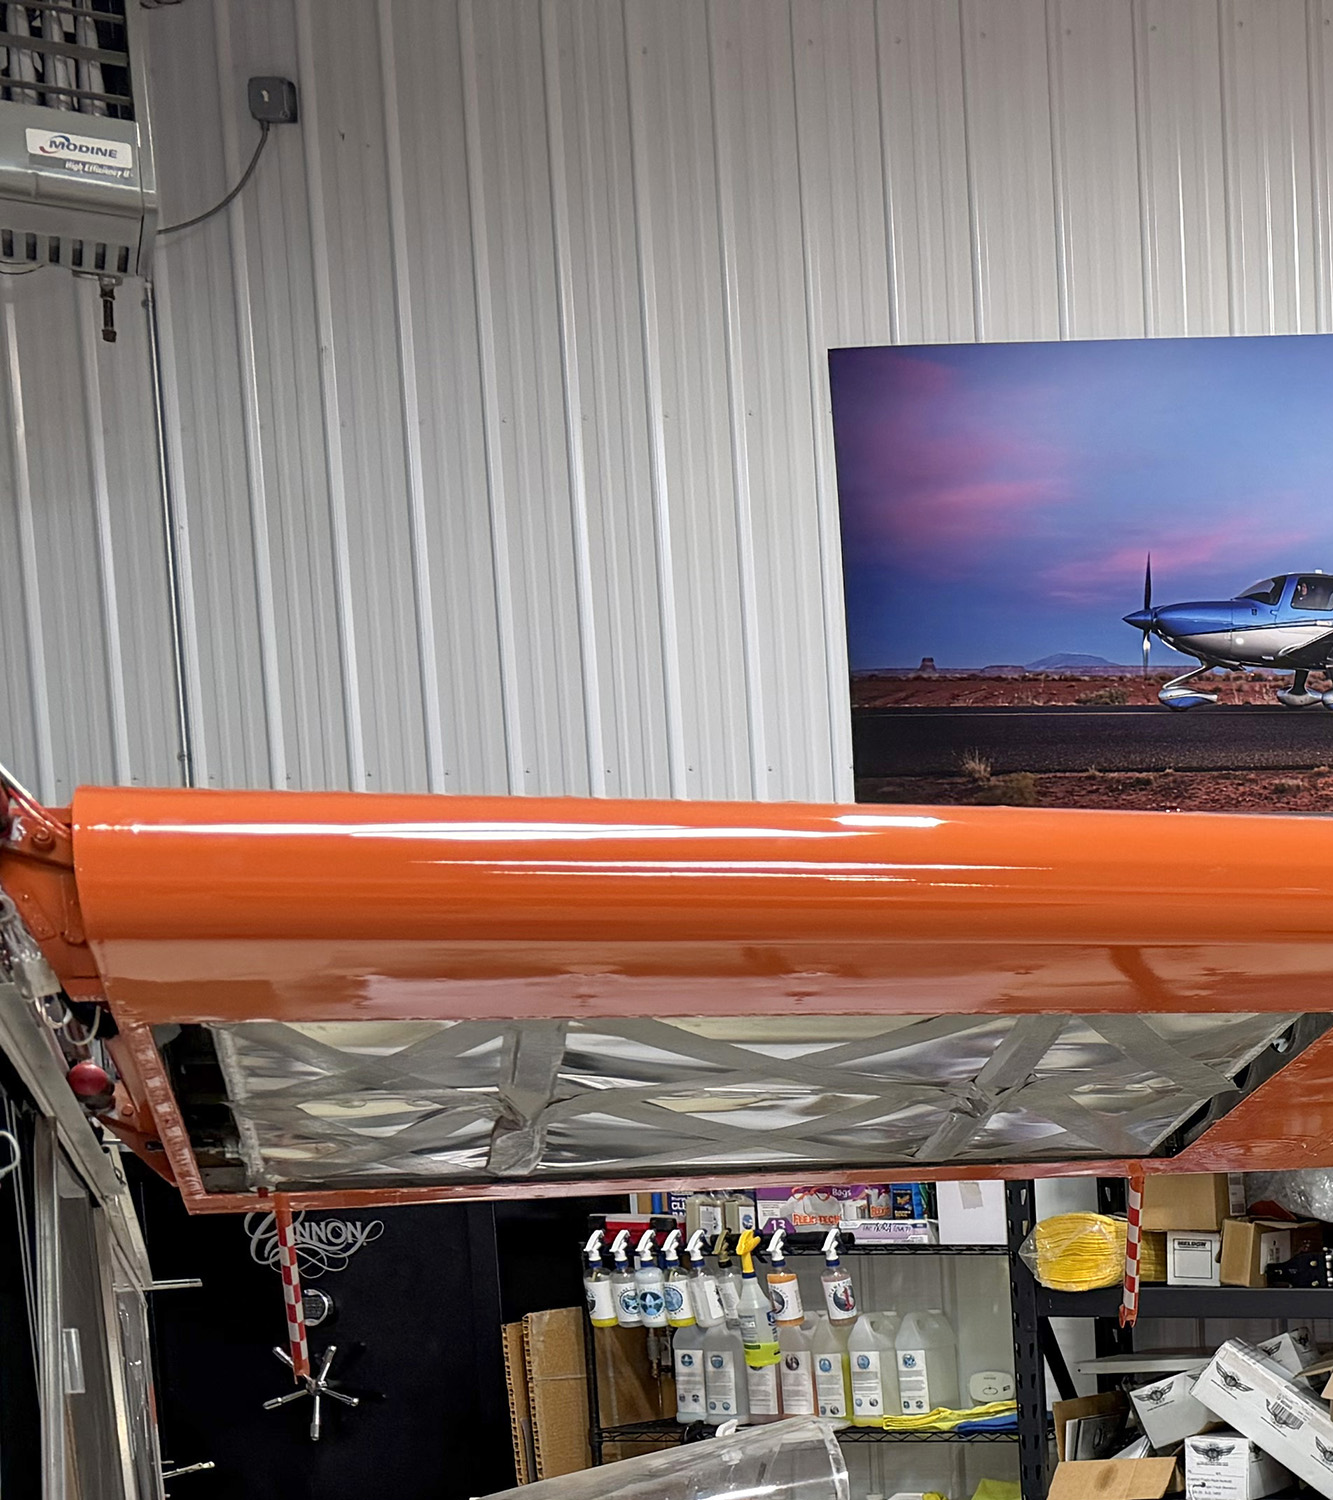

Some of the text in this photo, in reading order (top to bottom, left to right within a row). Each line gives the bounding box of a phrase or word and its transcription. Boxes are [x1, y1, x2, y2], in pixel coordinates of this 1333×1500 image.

[49, 140, 118, 159] MODINE
[832, 1187, 852, 1201] Bags
[244, 1211, 384, 1266] CNNON
